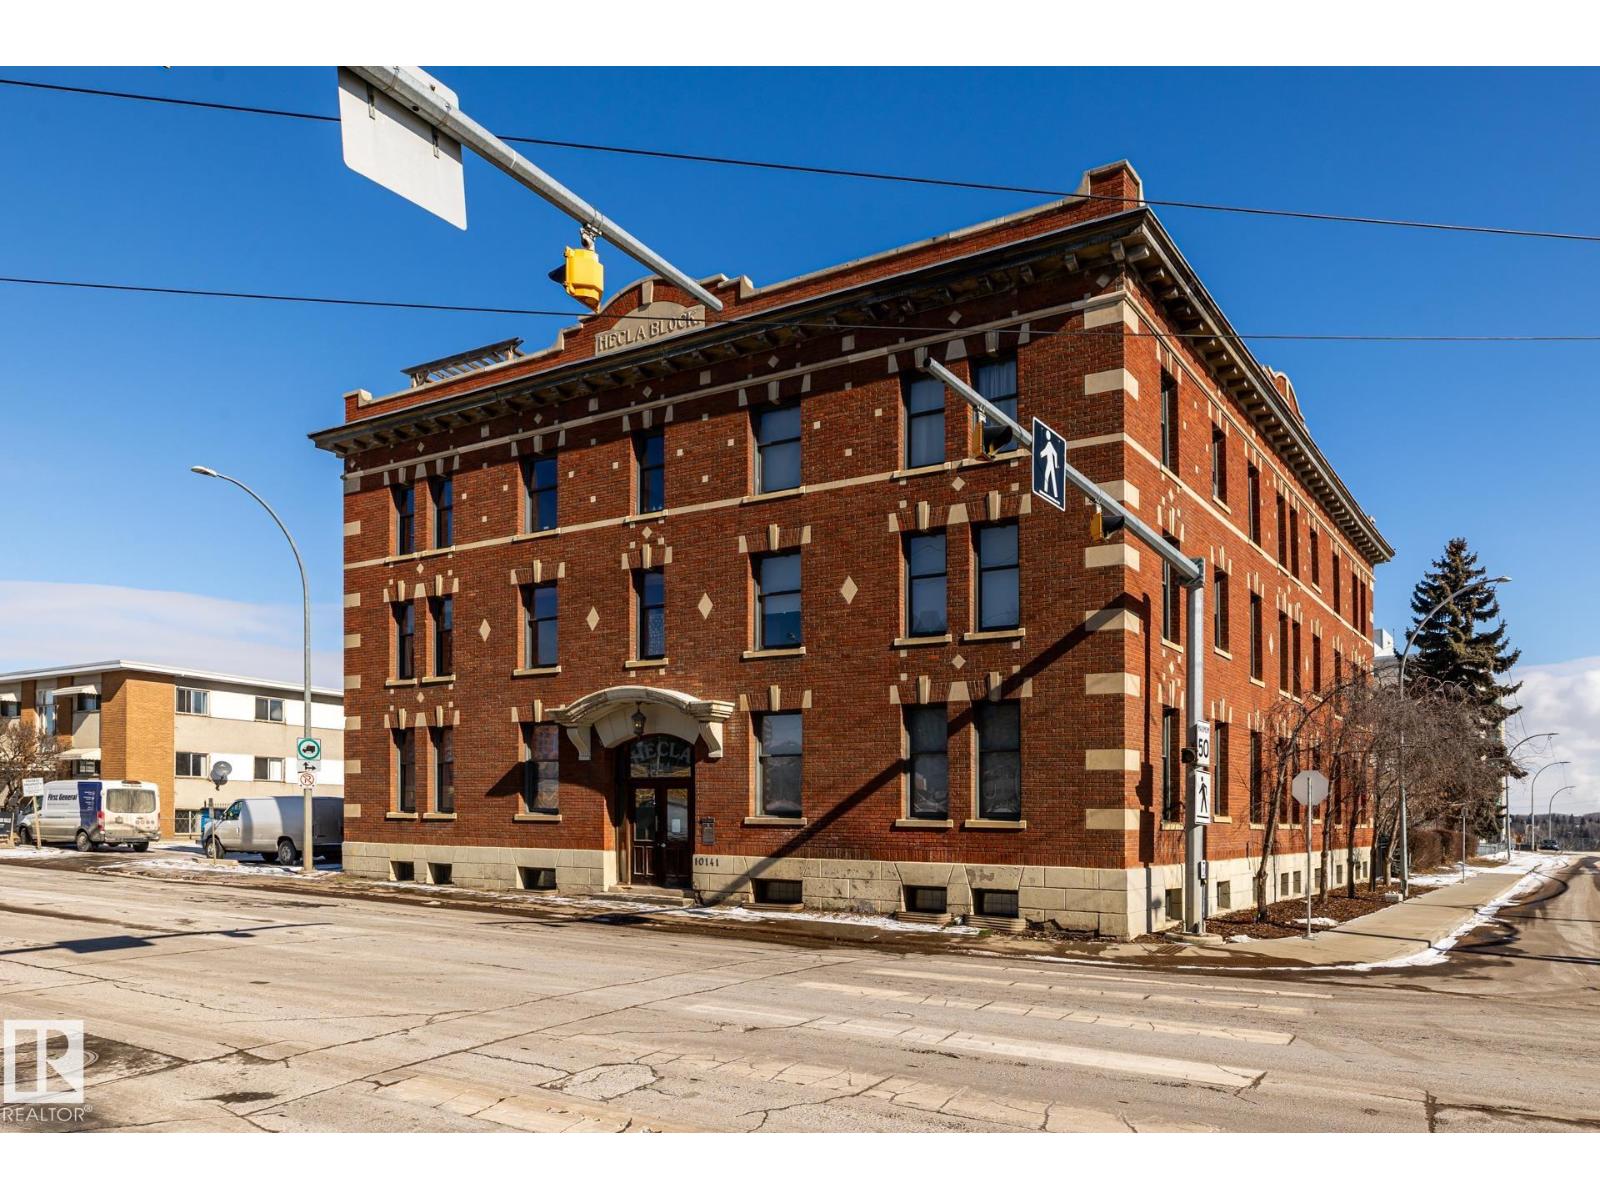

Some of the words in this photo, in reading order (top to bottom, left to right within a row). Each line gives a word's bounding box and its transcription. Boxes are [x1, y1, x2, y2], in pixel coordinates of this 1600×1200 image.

[599, 325, 647, 352] HECLA
[1198, 738, 1209, 758] 50
[47, 793, 58, 801] First
[58, 793, 78, 801] General
[694, 857, 720, 868] 10141
